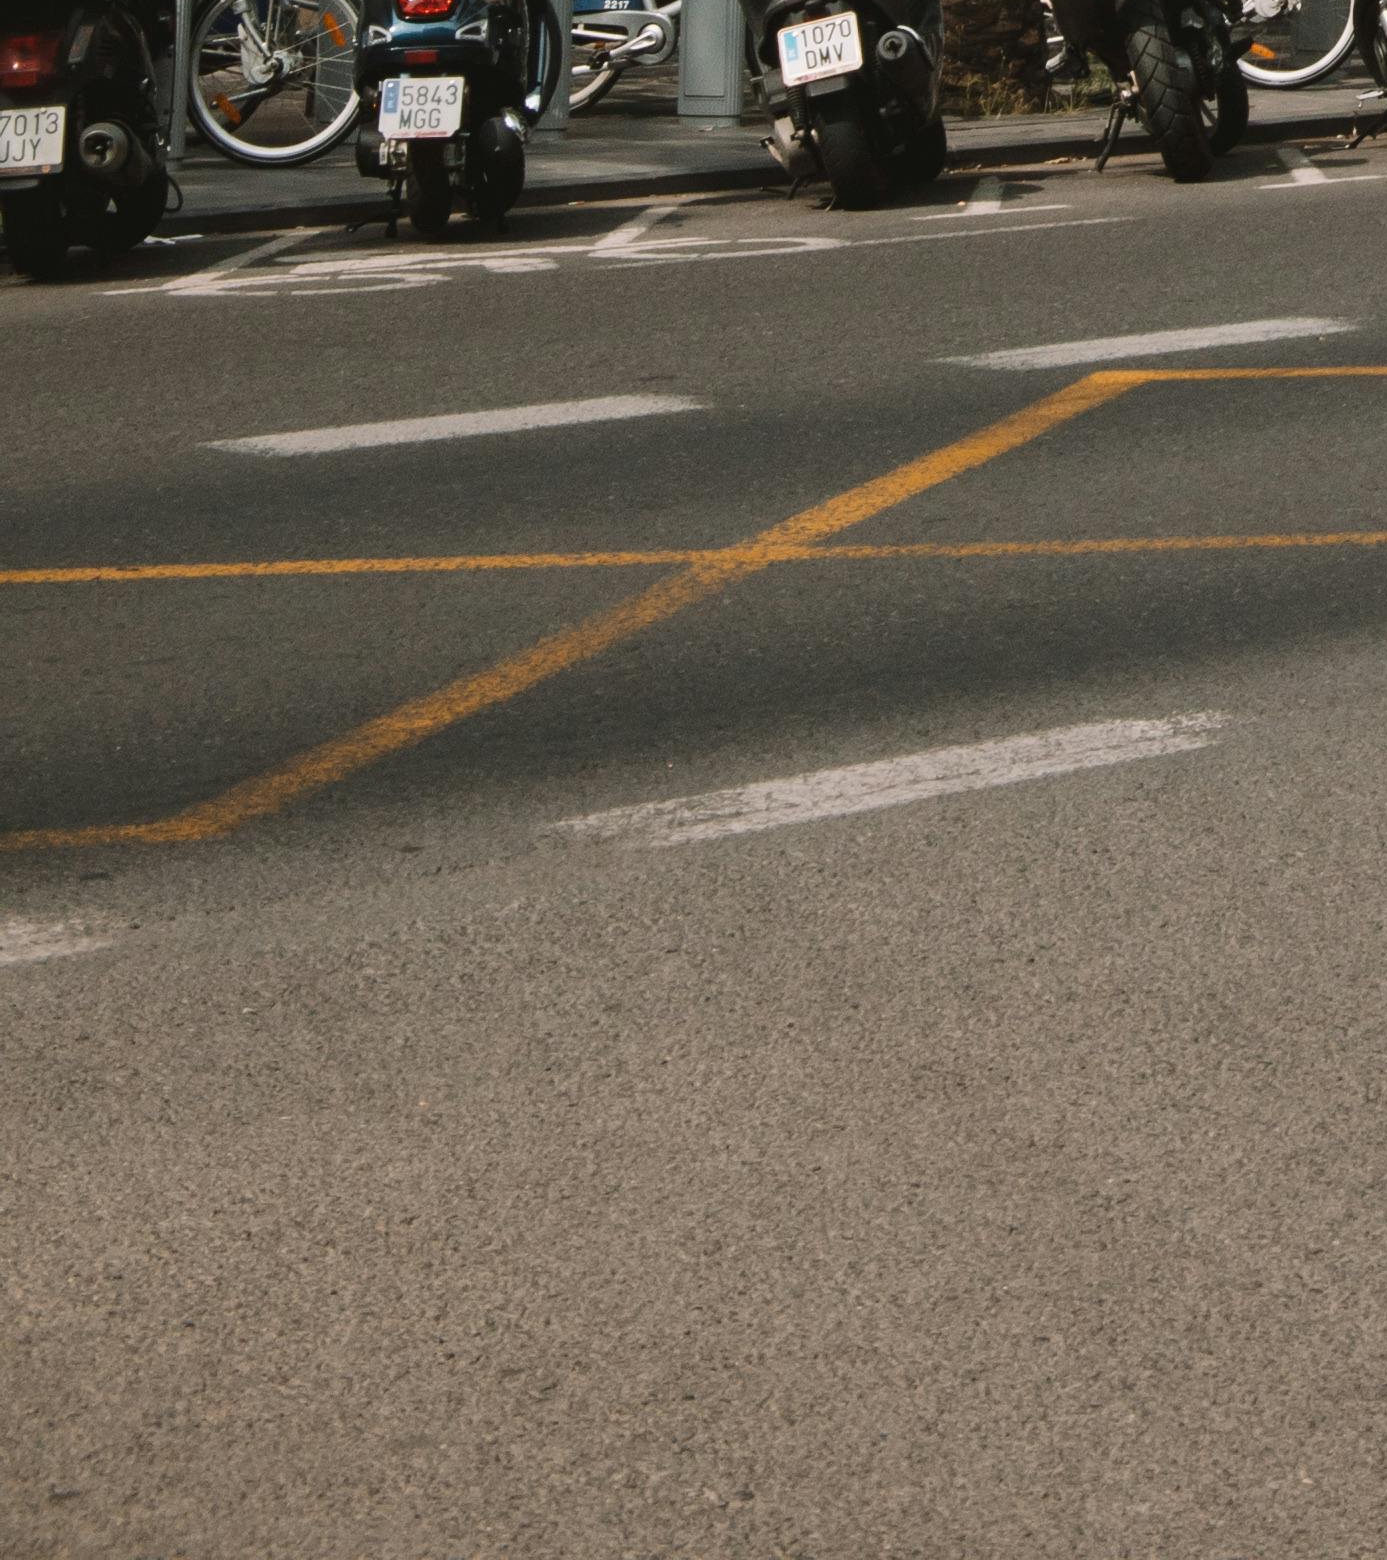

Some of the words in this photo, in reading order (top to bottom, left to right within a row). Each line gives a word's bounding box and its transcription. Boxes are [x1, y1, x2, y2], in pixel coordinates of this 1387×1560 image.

[603, 0, 630, 10] 2217
[801, 19, 852, 47] 1070
[804, 43, 844, 70] DMV
[401, 85, 458, 106] 5843
[0, 112, 59, 137] 7013
[399, 108, 441, 129] MGG
